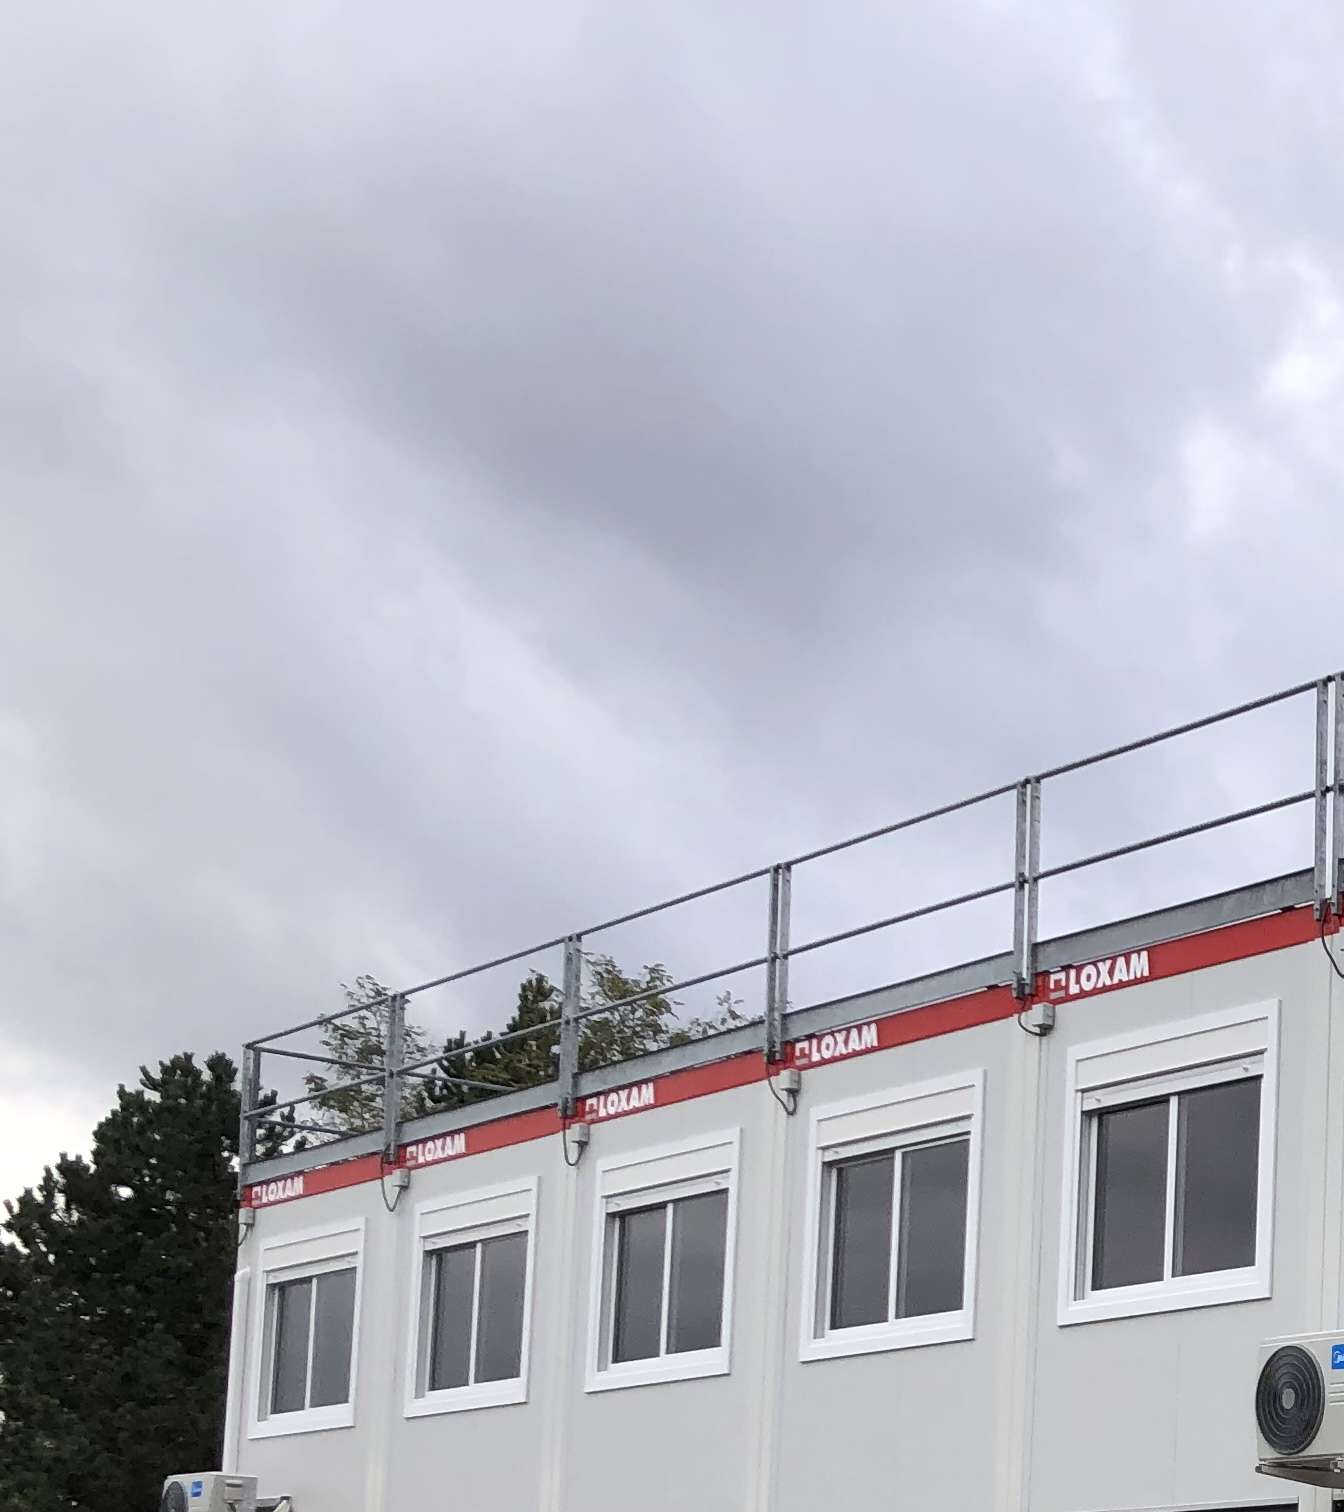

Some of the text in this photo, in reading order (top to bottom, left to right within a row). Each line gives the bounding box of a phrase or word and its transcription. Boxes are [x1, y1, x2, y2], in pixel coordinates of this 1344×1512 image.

[1069, 950, 1149, 995] LOXAM
[811, 1022, 878, 1062] LOXAM
[598, 1082, 655, 1117] LOXAM
[418, 1132, 466, 1163] LOXAM
[262, 1175, 304, 1203] LOXAM
